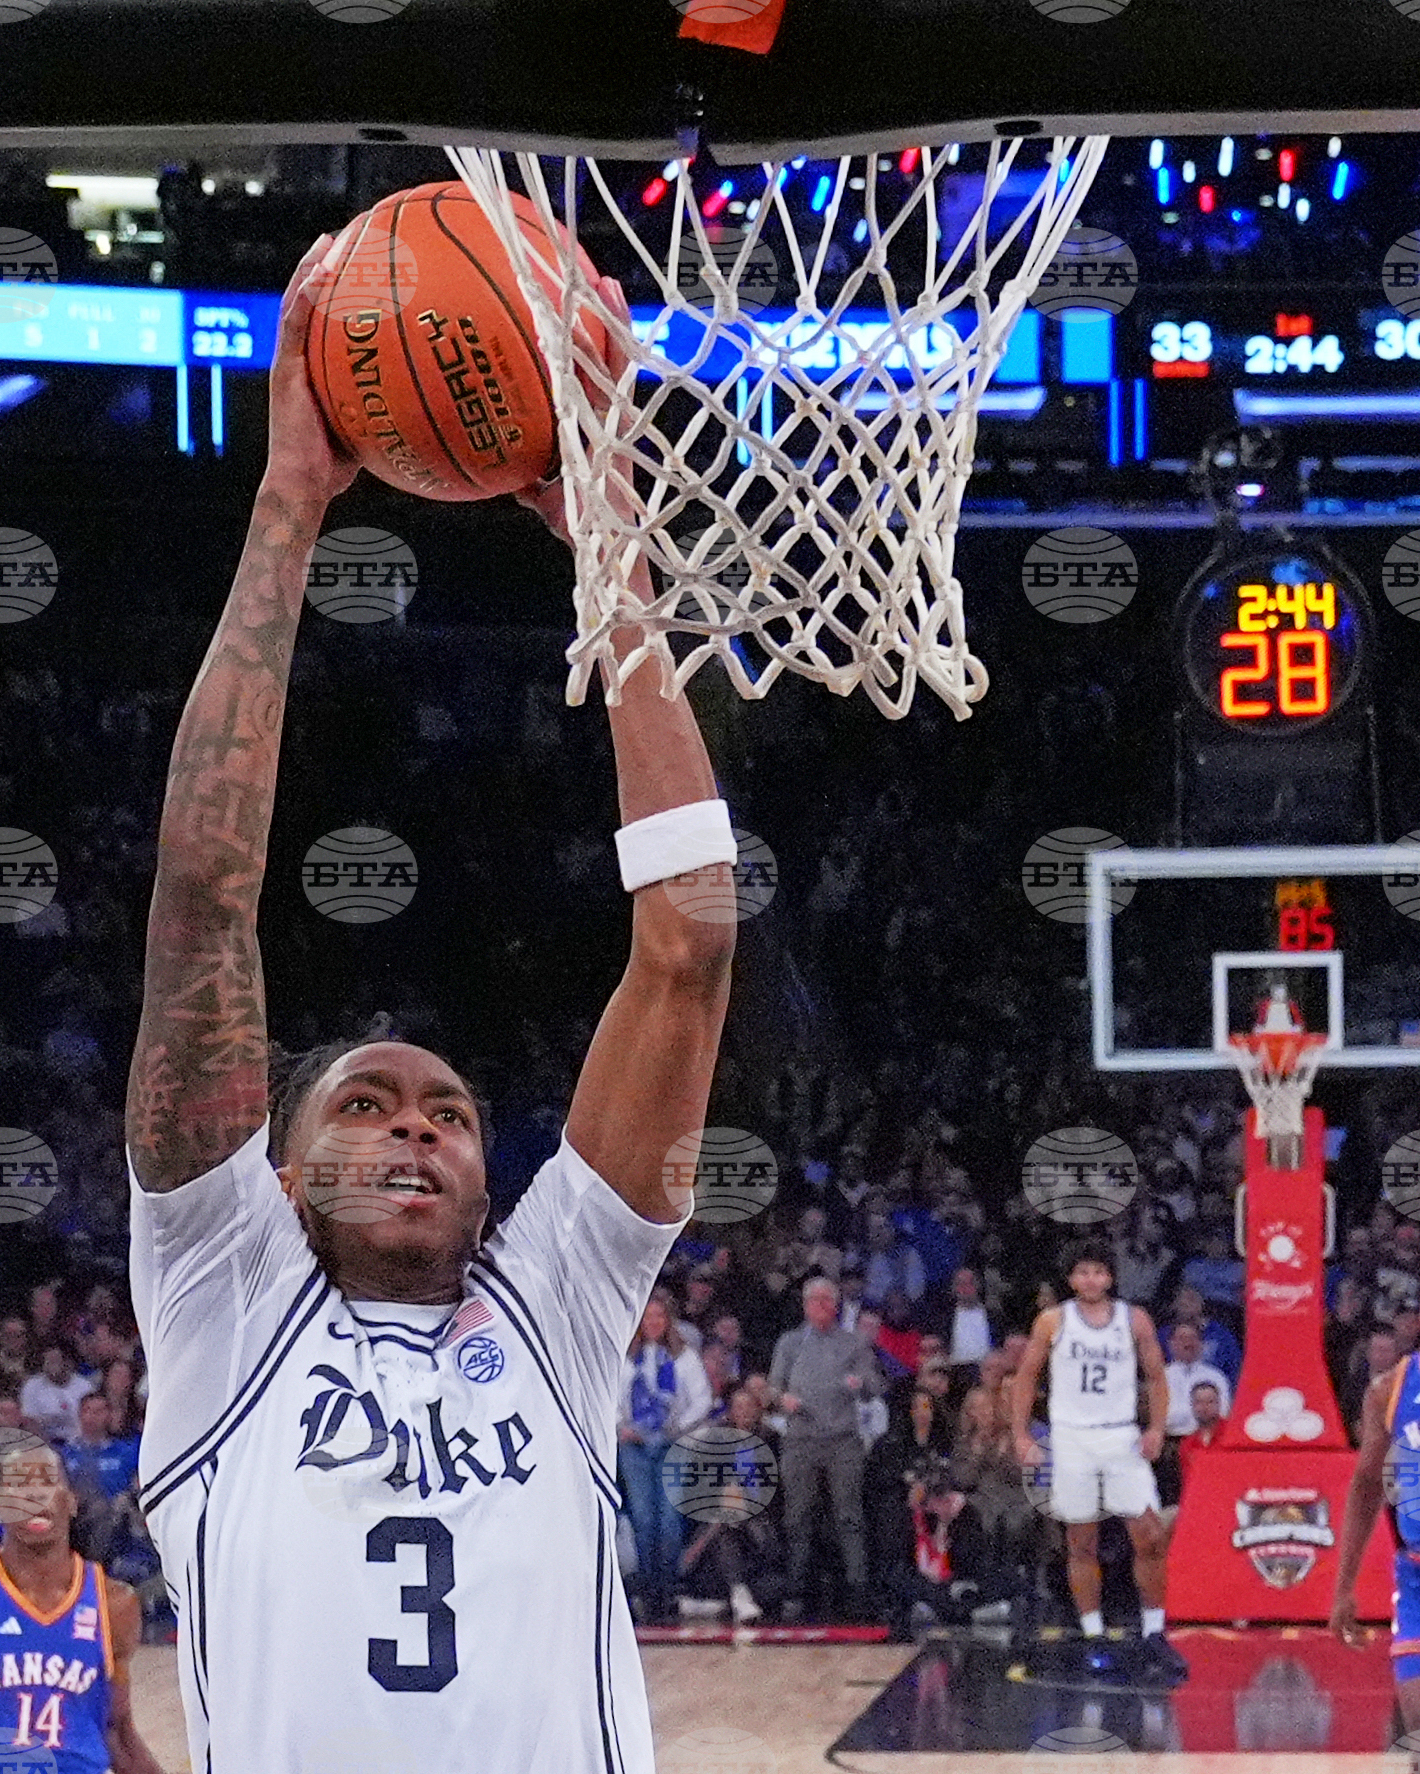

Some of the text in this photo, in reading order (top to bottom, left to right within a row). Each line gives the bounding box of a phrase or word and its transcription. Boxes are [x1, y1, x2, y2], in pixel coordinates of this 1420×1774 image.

[1150, 321, 1213, 362] 33
[1244, 334, 1345, 374] 2:44
[418, 309, 507, 470] LEGACY
[1238, 582, 1335, 632] 2:44
[1220, 630, 1330, 719] 28
[1081, 1363, 1107, 1394] 12
[295, 1364, 537, 1500] Duke
[366, 1516, 458, 1692] 3
[12, 1692, 64, 1748] 14
